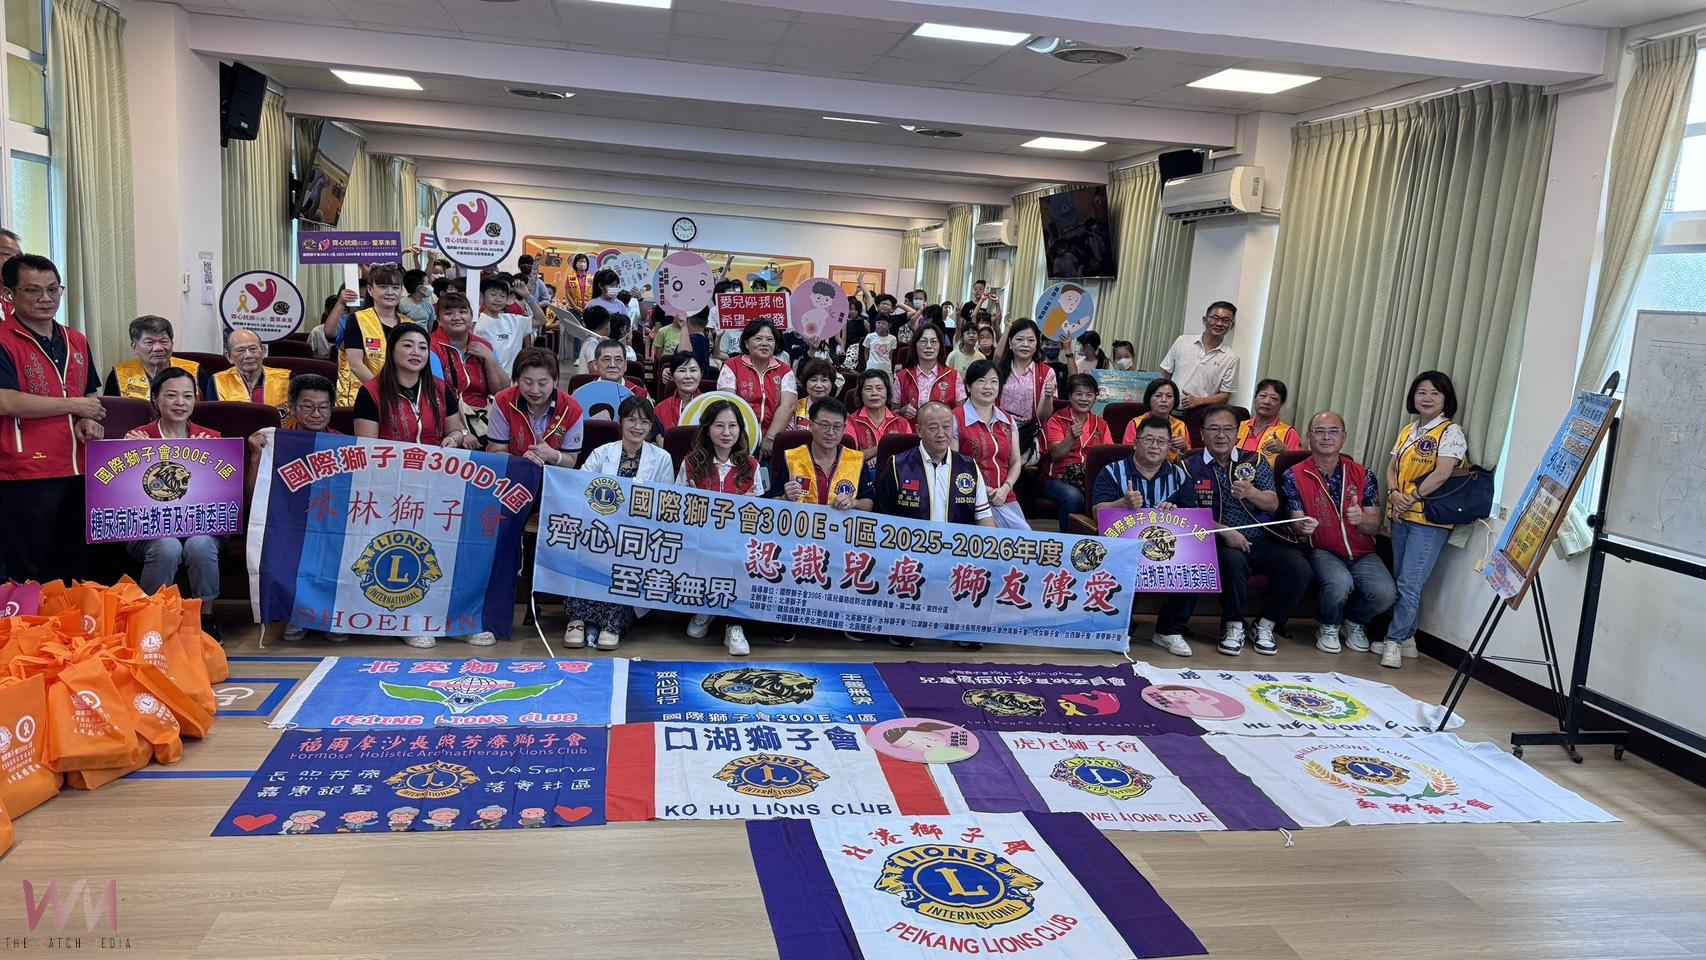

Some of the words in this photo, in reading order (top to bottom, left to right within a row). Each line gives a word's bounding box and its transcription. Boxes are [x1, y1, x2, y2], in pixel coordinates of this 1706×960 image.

[720, 295, 785, 309] 愛兒你我他
[721, 312, 785, 327] 希望一發
[94, 443, 237, 485] 國際獅子會300E-1區
[277, 445, 534, 515] 國際獅子會300D1區
[91, 501, 239, 541] 糖尿病防治教育及行動委員會
[304, 486, 507, 539] 水林獅子會
[377, 533, 428, 551] LIONS
[547, 514, 683, 564] 齊心同行
[387, 555, 409, 583] L
[369, 588, 420, 605] INTERNATIONAL
[609, 564, 738, 609] 至善無界
[298, 732, 587, 752] 福爾摩沙長照芳療獅子會
[664, 725, 861, 752] 口湖獅子會
[290, 752, 352, 760] Formosa
[360, 750, 412, 758] Holistic
[557, 746, 588, 755] Club
[664, 803, 698, 817] KO
[709, 804, 741, 816] HU
[752, 802, 821, 816] LIONS
[831, 803, 893, 816] CLUB
[902, 846, 988, 866] LIONS
[935, 867, 989, 897] L
[927, 902, 1024, 922] INTERNATIONAL
[886, 921, 979, 954] PEIKANG
[982, 932, 1043, 954] LIONS
[1038, 914, 1078, 942] CLUB
